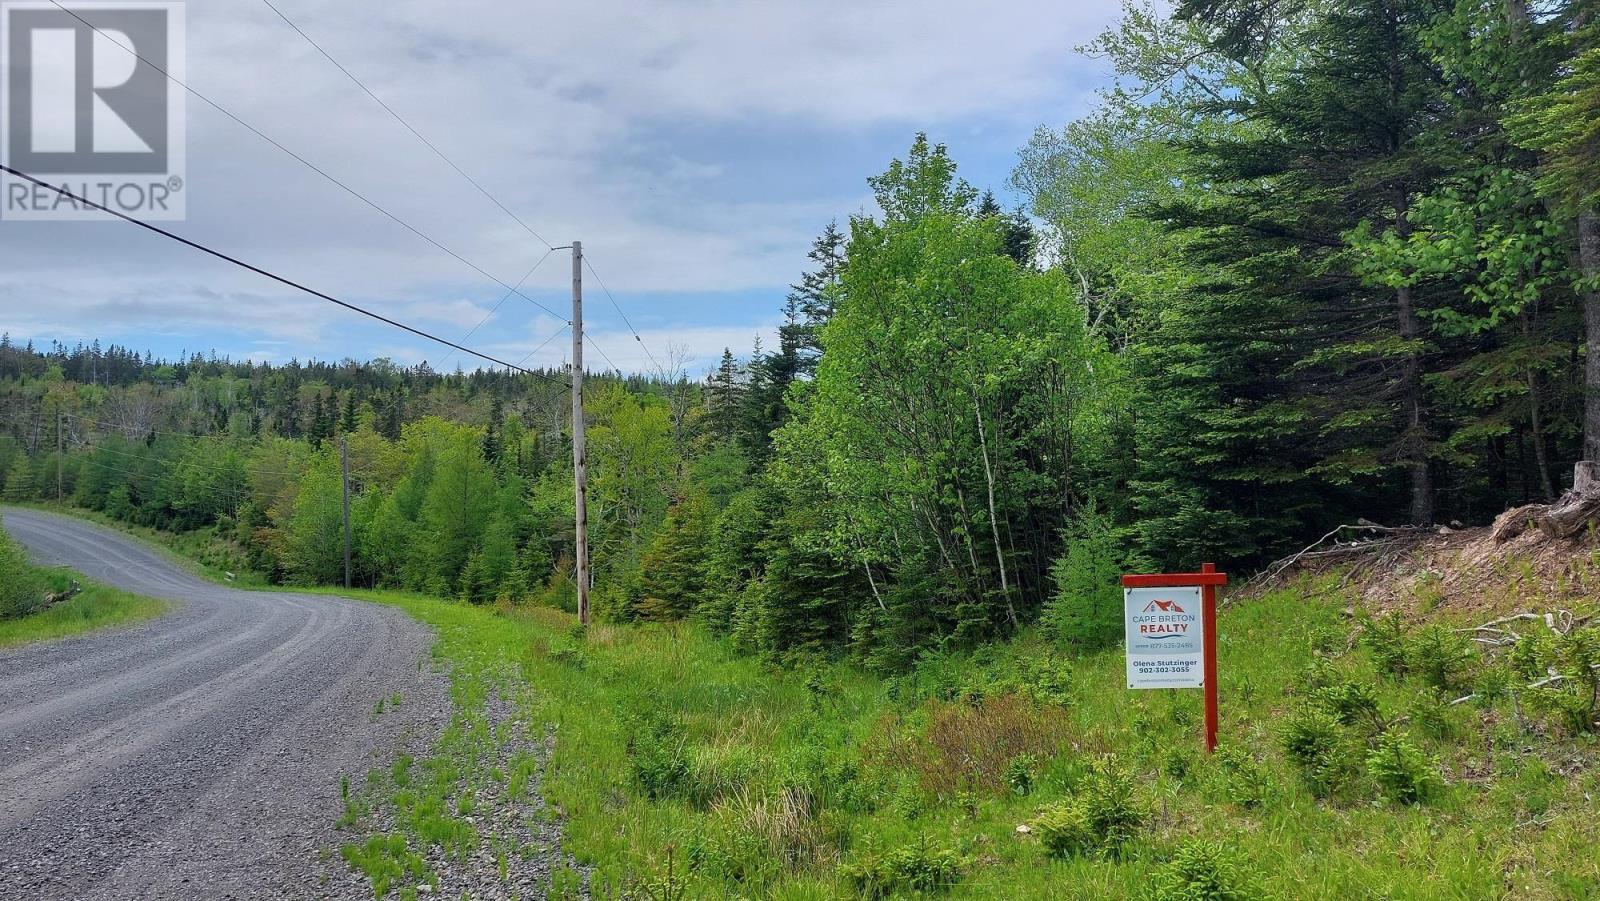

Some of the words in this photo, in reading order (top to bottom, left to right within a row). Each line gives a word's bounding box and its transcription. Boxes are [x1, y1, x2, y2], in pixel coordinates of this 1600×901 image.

[1132, 615, 1156, 623] CAPE
[1158, 614, 1195, 622] BRETON
[1140, 623, 1188, 633] REALTY
